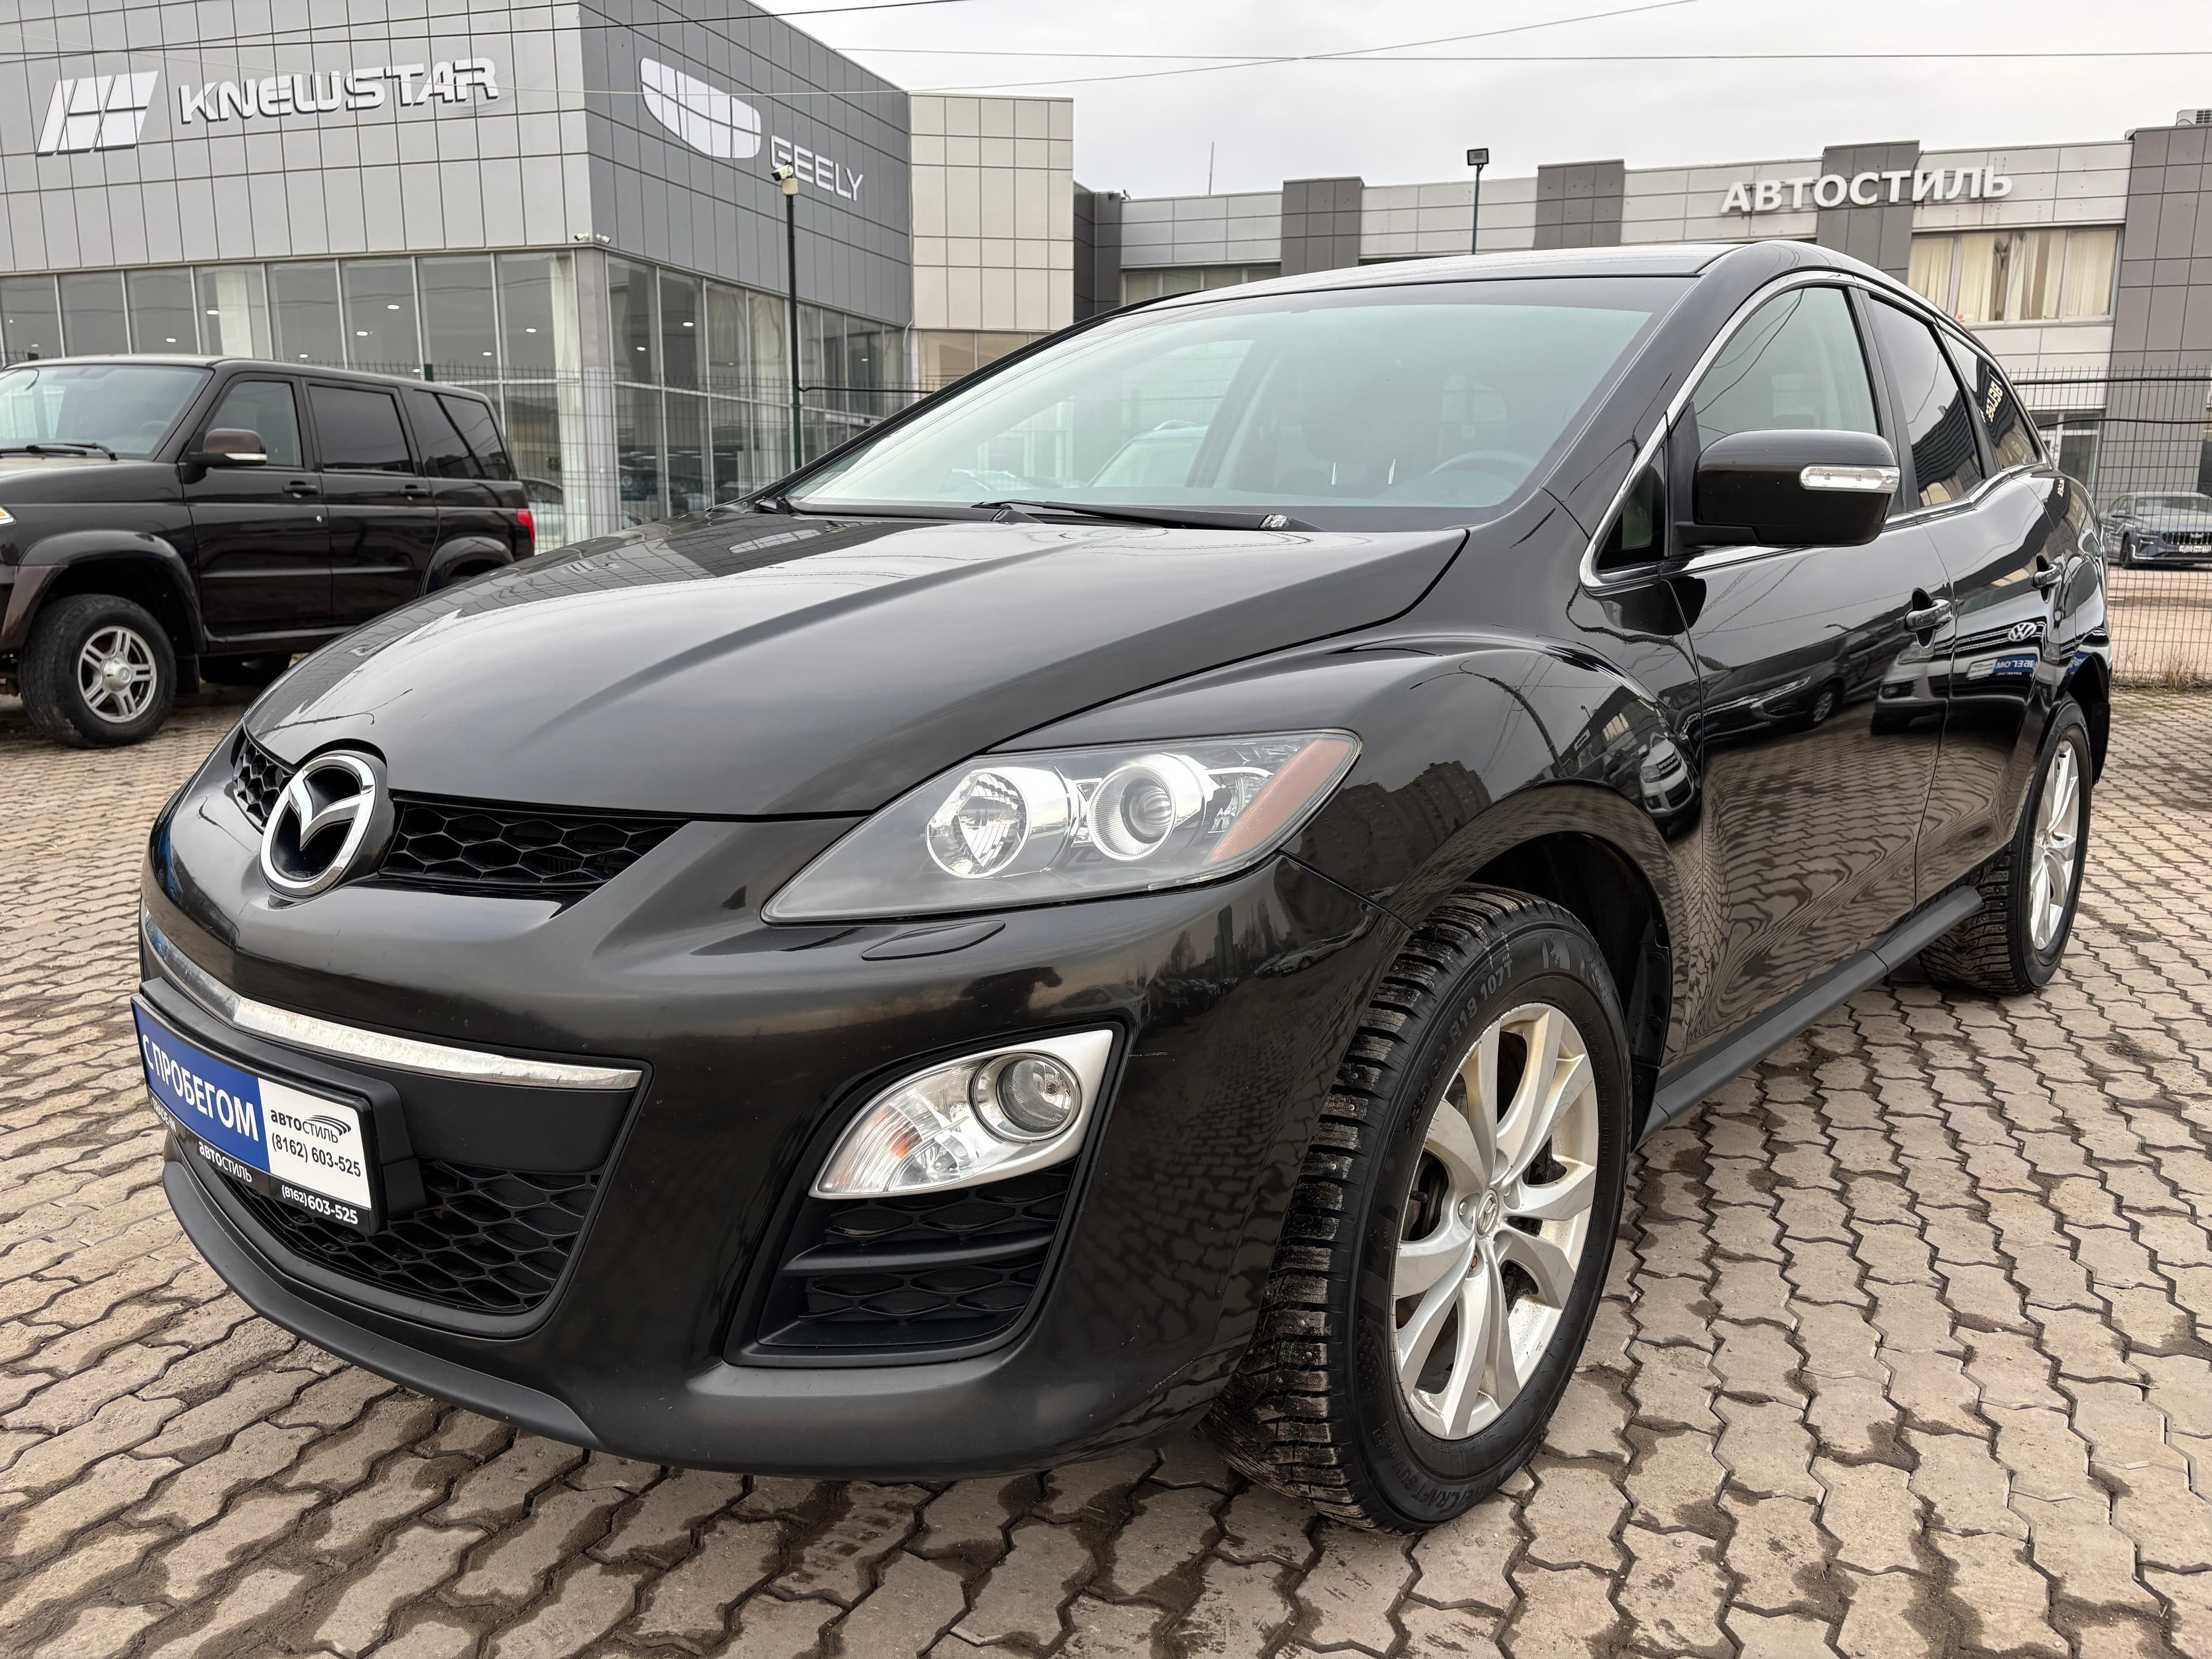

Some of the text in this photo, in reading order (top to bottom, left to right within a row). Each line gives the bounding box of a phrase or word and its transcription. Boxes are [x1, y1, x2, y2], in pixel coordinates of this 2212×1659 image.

[179, 58, 499, 123] KNEWSTAR
[770, 135, 863, 201] GEELY
[1720, 165, 2013, 213] АВТОСТИЛЬ
[143, 1034, 259, 1142] С ПРОБЕГОМ
[151, 1097, 176, 1132] TRADE-IN
[272, 1132, 361, 1177] (8162) 603-525
